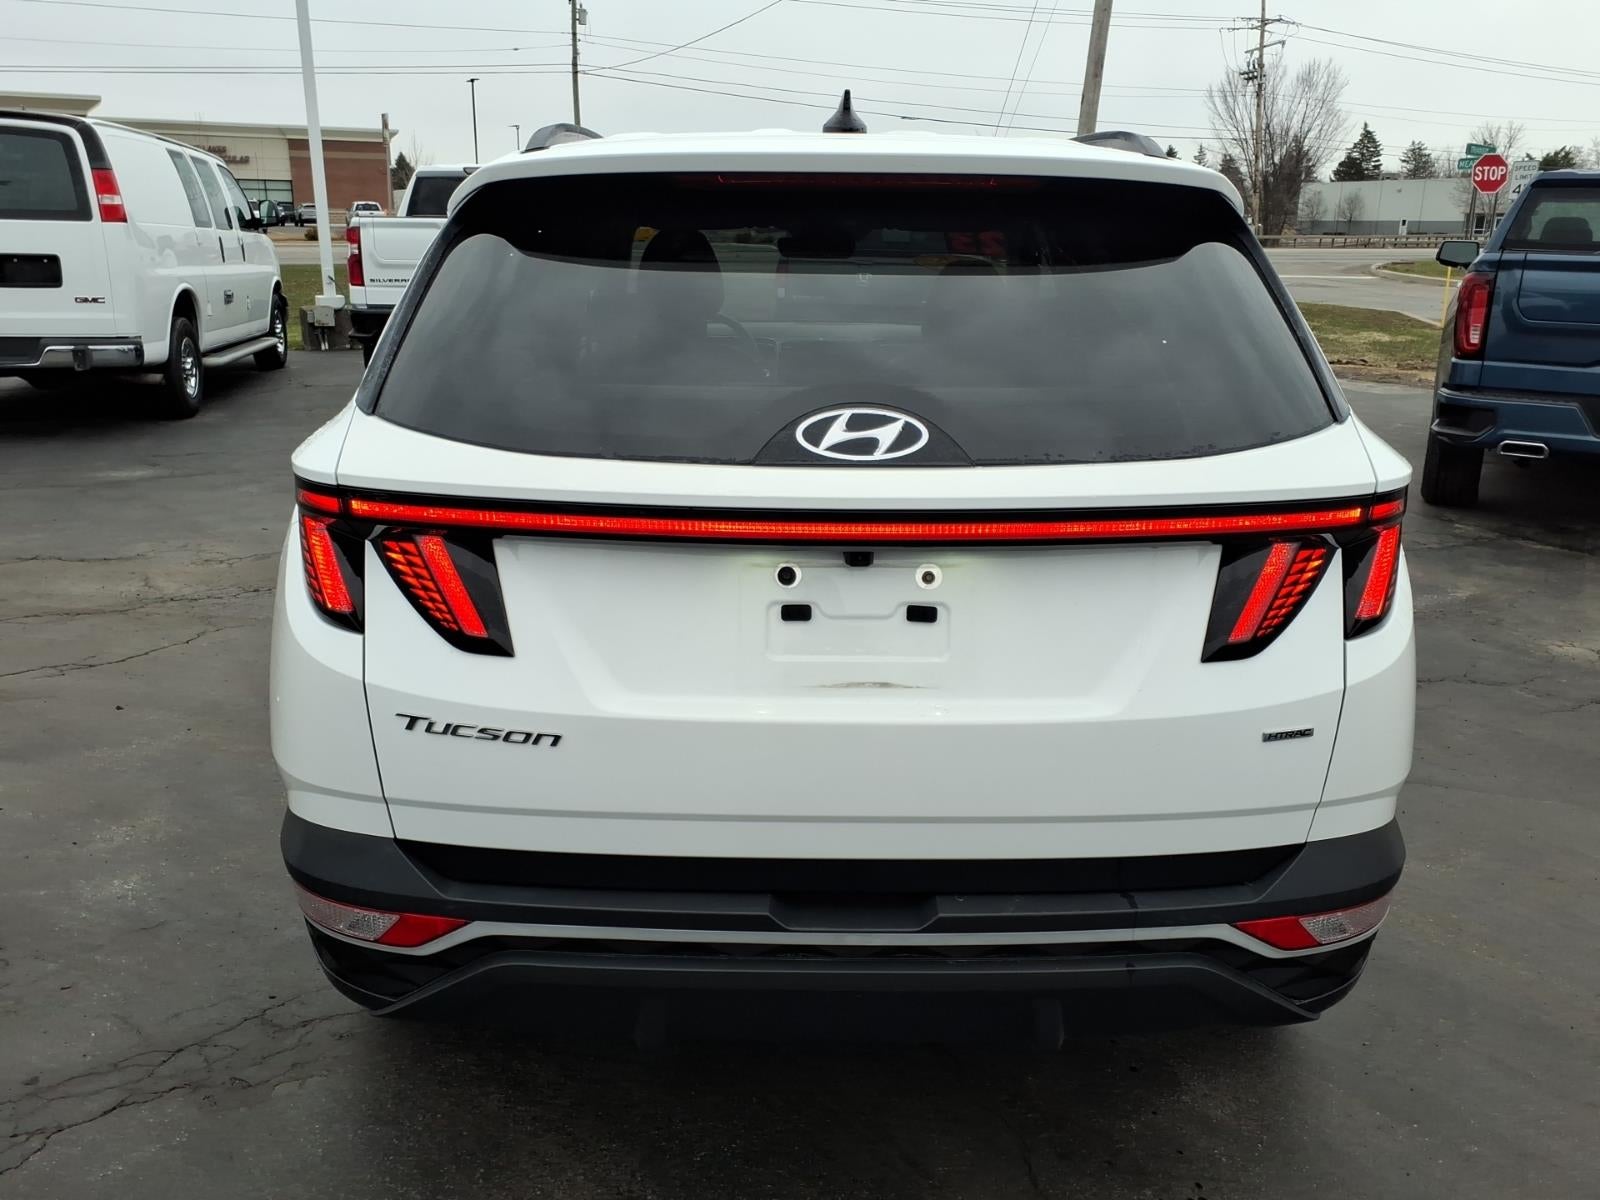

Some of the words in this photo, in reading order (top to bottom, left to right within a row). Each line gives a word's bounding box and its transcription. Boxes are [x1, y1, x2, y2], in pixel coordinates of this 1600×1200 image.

[1474, 166, 1507, 181] STOP
[74, 296, 106, 304] GMC
[1262, 727, 1314, 742] HTRAC
